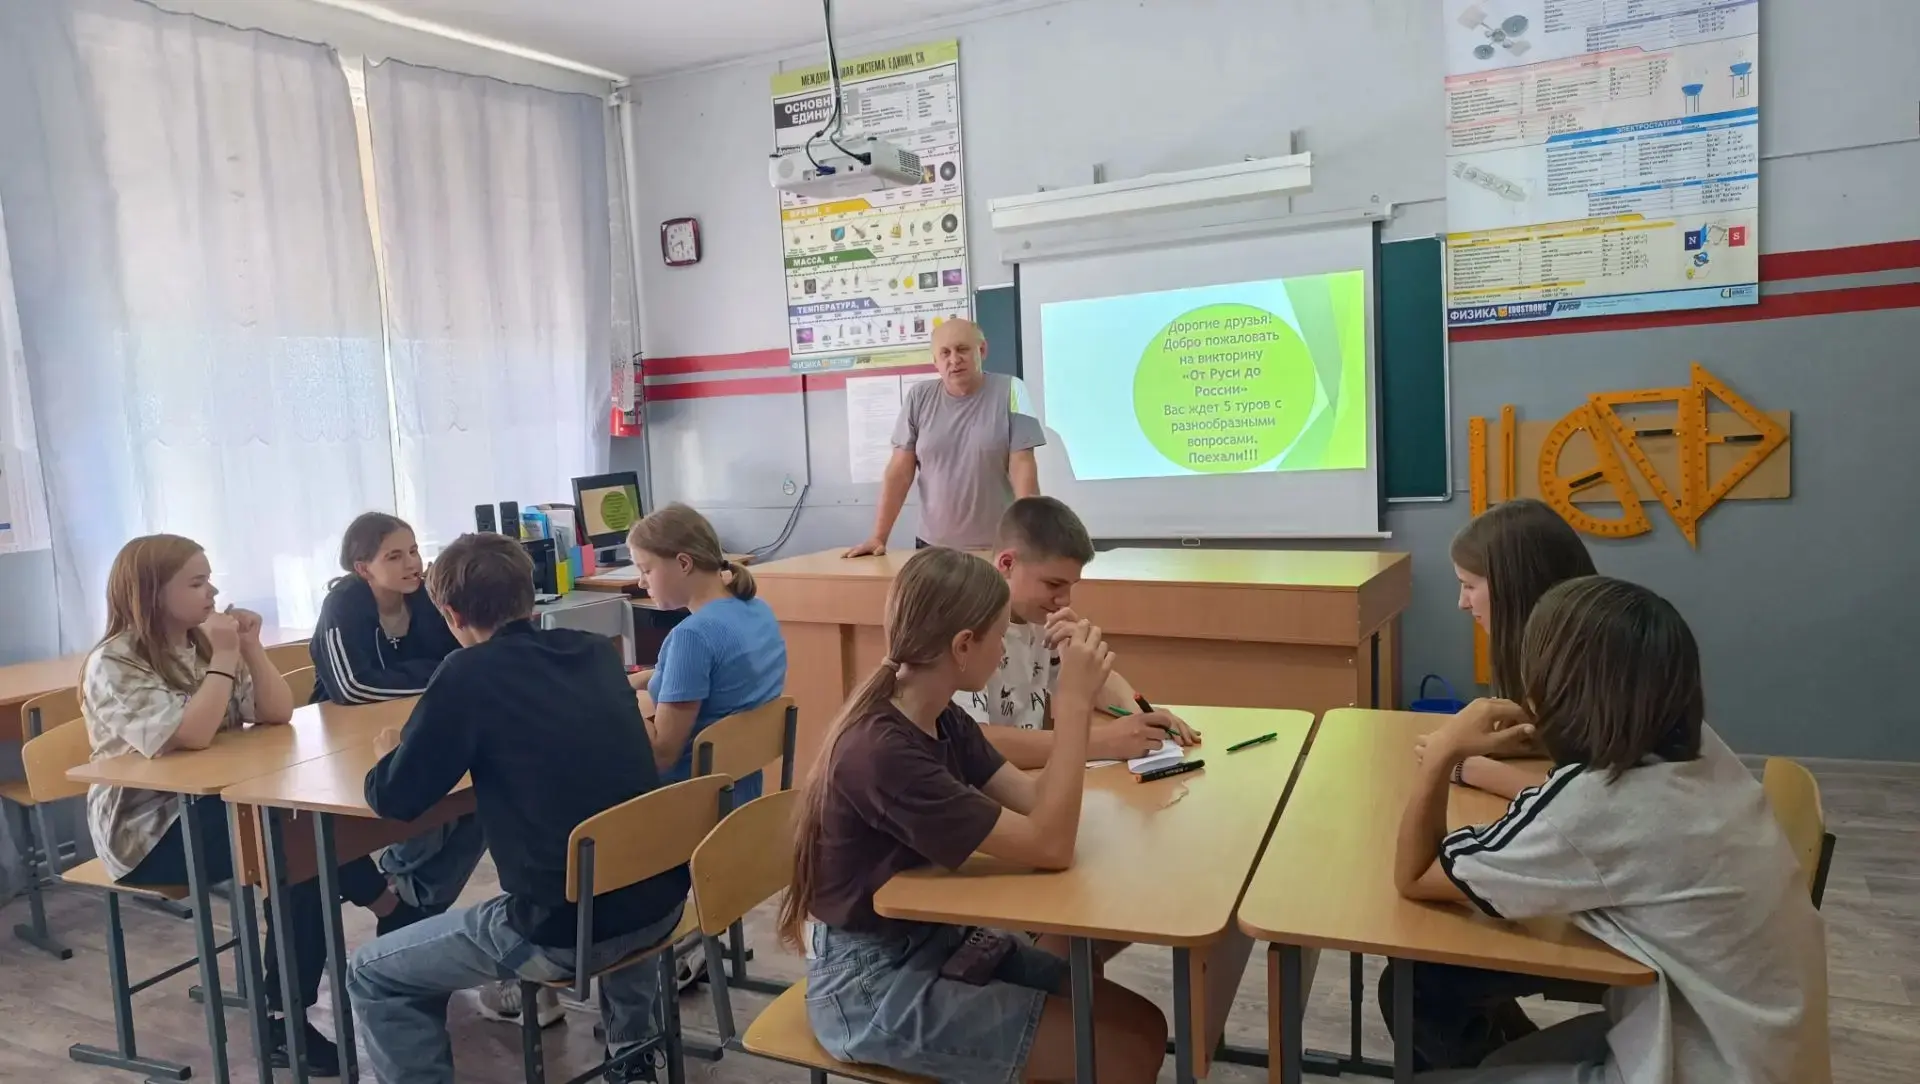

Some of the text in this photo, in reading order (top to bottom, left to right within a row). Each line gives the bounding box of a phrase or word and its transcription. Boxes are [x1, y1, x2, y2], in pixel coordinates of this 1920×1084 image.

[801, 65, 854, 86] МЕЖДУНАНАЯ
[857, 59, 886, 75] СИСТЕМА
[888, 53, 914, 70] ЕДИНИЦ
[784, 92, 848, 114] ОСНОВНЕ
[1616, 119, 1683, 134] ЭЛЕКТРОСТАТИКА
[1688, 236, 1697, 245] N
[1733, 232, 1740, 240] S
[793, 256, 825, 267] МАССА,
[797, 301, 860, 314] ТЕМПЕРАТУРА,
[1450, 307, 1497, 321] ФИЗИКА
[1168, 312, 1272, 335] Дорогие друзья!
[1163, 331, 1280, 352] Добро пожаловать
[1179, 349, 1263, 365] на викторину
[1182, 367, 1261, 383] «От Руси до
[1194, 384, 1248, 397] России»
[1164, 399, 1282, 416] Вас ждет 5 туров с
[1171, 418, 1276, 434] разнообразными
[1187, 436, 1258, 449] вопросами.
[1188, 449, 1258, 463] Поехали!!!
